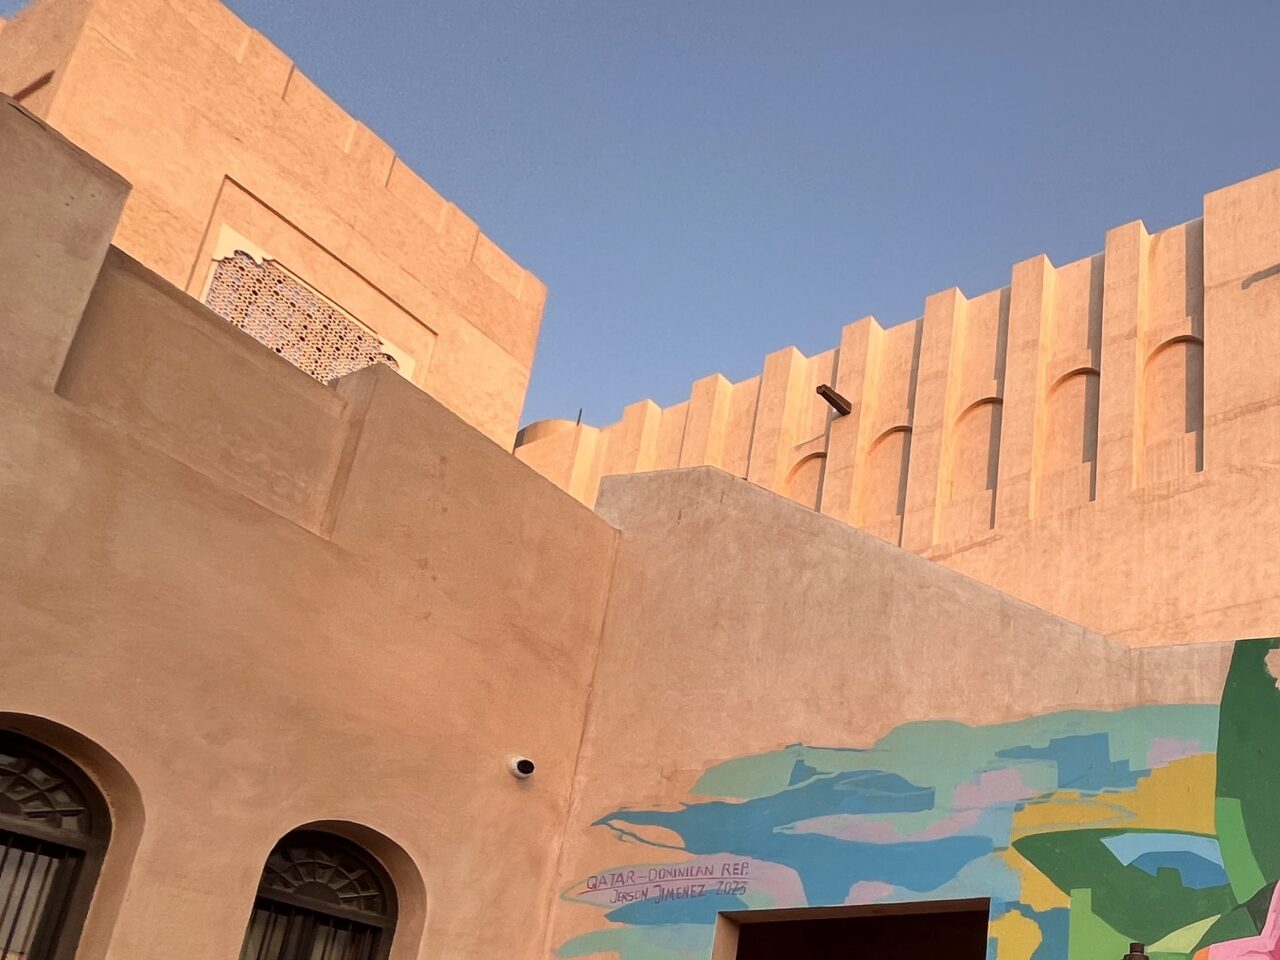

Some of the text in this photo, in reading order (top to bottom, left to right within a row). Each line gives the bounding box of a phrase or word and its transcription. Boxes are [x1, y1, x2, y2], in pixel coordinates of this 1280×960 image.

[721, 862, 750, 876] REP.
[653, 884, 706, 904] JIMENEZ
[715, 880, 748, 896] 2023
